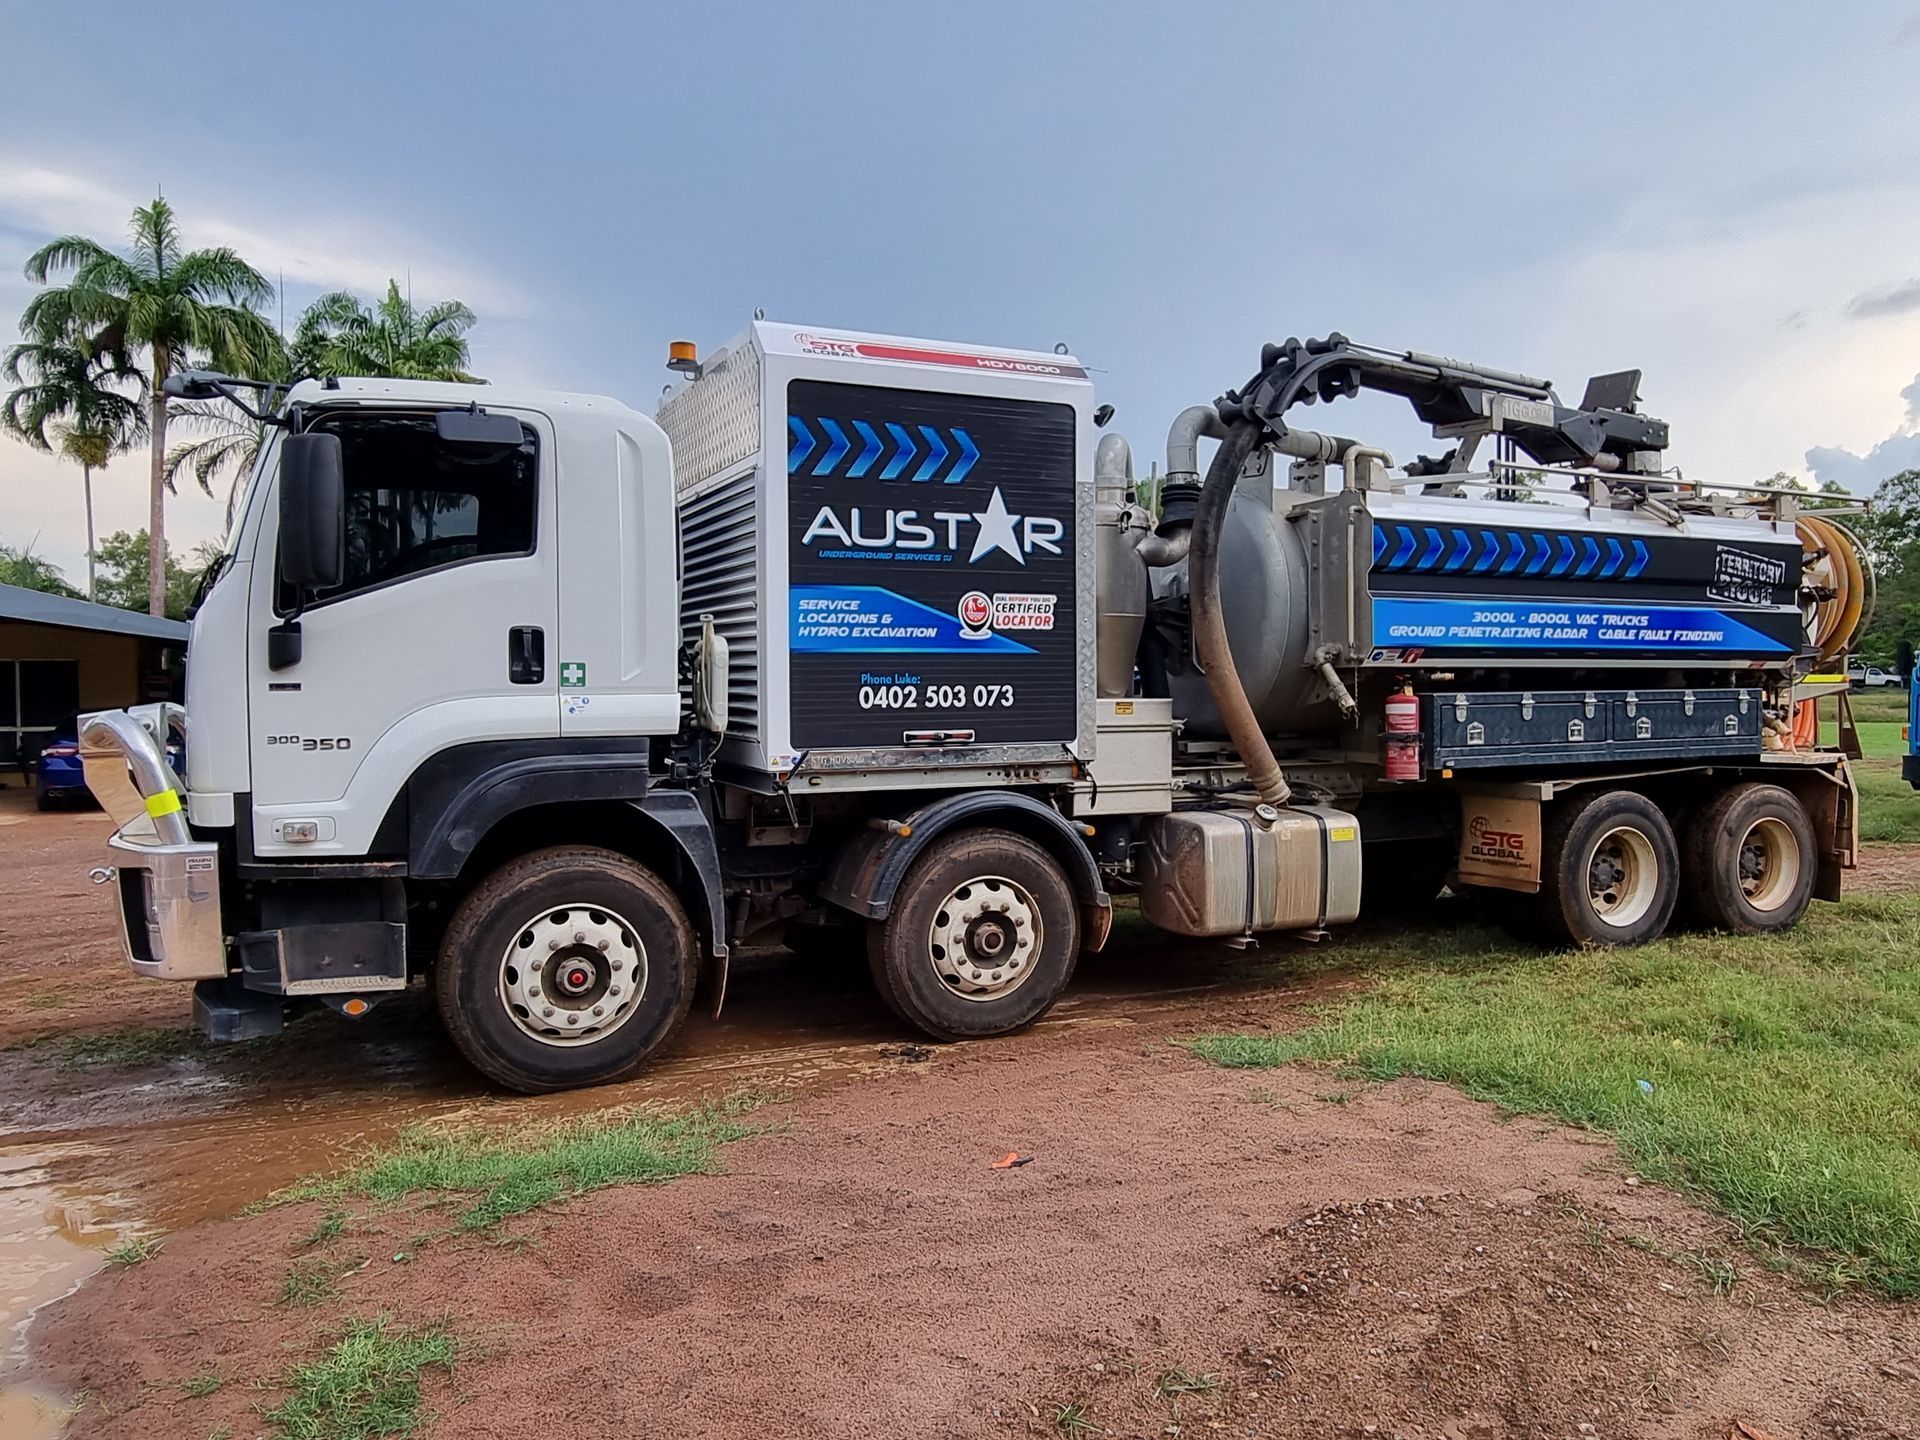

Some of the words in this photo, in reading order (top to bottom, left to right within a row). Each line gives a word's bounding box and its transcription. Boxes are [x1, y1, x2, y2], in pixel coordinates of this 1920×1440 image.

[803, 348, 857, 358] GLOBAL
[810, 341, 854, 353] STG
[976, 359, 1060, 374] HDV8000
[819, 550, 892, 559] UNDERGROUND
[894, 552, 941, 562] SERVICES
[1721, 552, 1782, 585] TERRITORY
[798, 599, 861, 610] SERVICE
[995, 603, 1051, 614] CERTIFIED
[798, 612, 879, 624] LOCATIONS
[881, 614, 894, 624] &
[995, 615, 1052, 627] LOCATOR
[1471, 611, 1516, 623] 3000L
[1528, 612, 1571, 624] 8000L
[1576, 613, 1599, 625] VAC
[1602, 614, 1649, 627] TRUCKS
[798, 626, 849, 637] HYDRO
[851, 627, 938, 638] EXCAVATION
[1389, 625, 1446, 637] GROUND
[1448, 626, 1541, 639] PENETRATING
[1543, 627, 1588, 639] RADAR
[1598, 628, 1637, 640] CABLE
[1638, 629, 1672, 641] FAULT
[1673, 630, 1723, 642] FINDING
[861, 673, 892, 684] Phone
[895, 673, 921, 684] Luke:
[859, 685, 917, 709] 0402
[924, 685, 967, 708] 503
[973, 684, 1014, 707] 073
[266, 735, 300, 745] 300
[302, 737, 351, 751] 350
[1481, 830, 1524, 850] STG
[1471, 845, 1525, 860] GLOBAL
